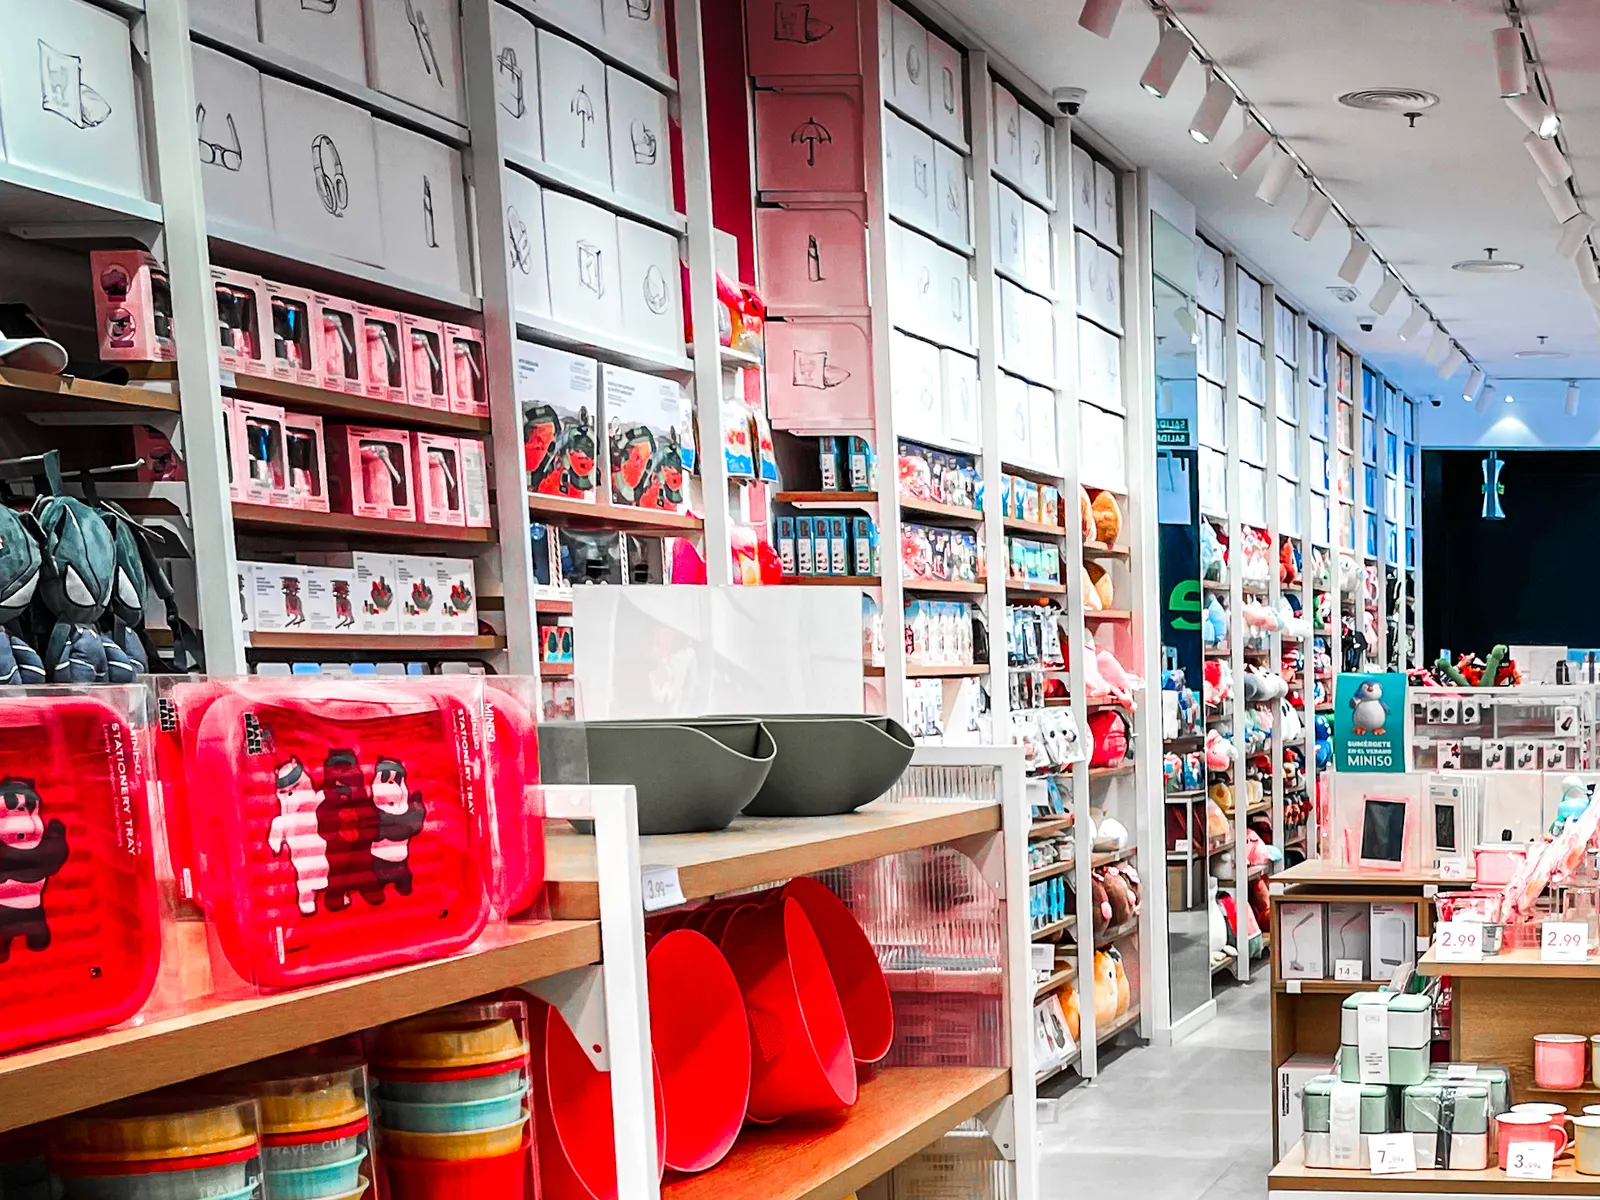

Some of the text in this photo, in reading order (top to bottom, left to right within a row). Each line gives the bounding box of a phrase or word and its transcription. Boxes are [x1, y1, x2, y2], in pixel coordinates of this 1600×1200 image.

[484, 703, 496, 743] MINISO
[457, 708, 475, 815] STATIONERY TRAY
[1347, 755, 1393, 767] MINISO
[111, 722, 137, 856] STATIONERY TRAY
[321, 1137, 347, 1153] CUP
